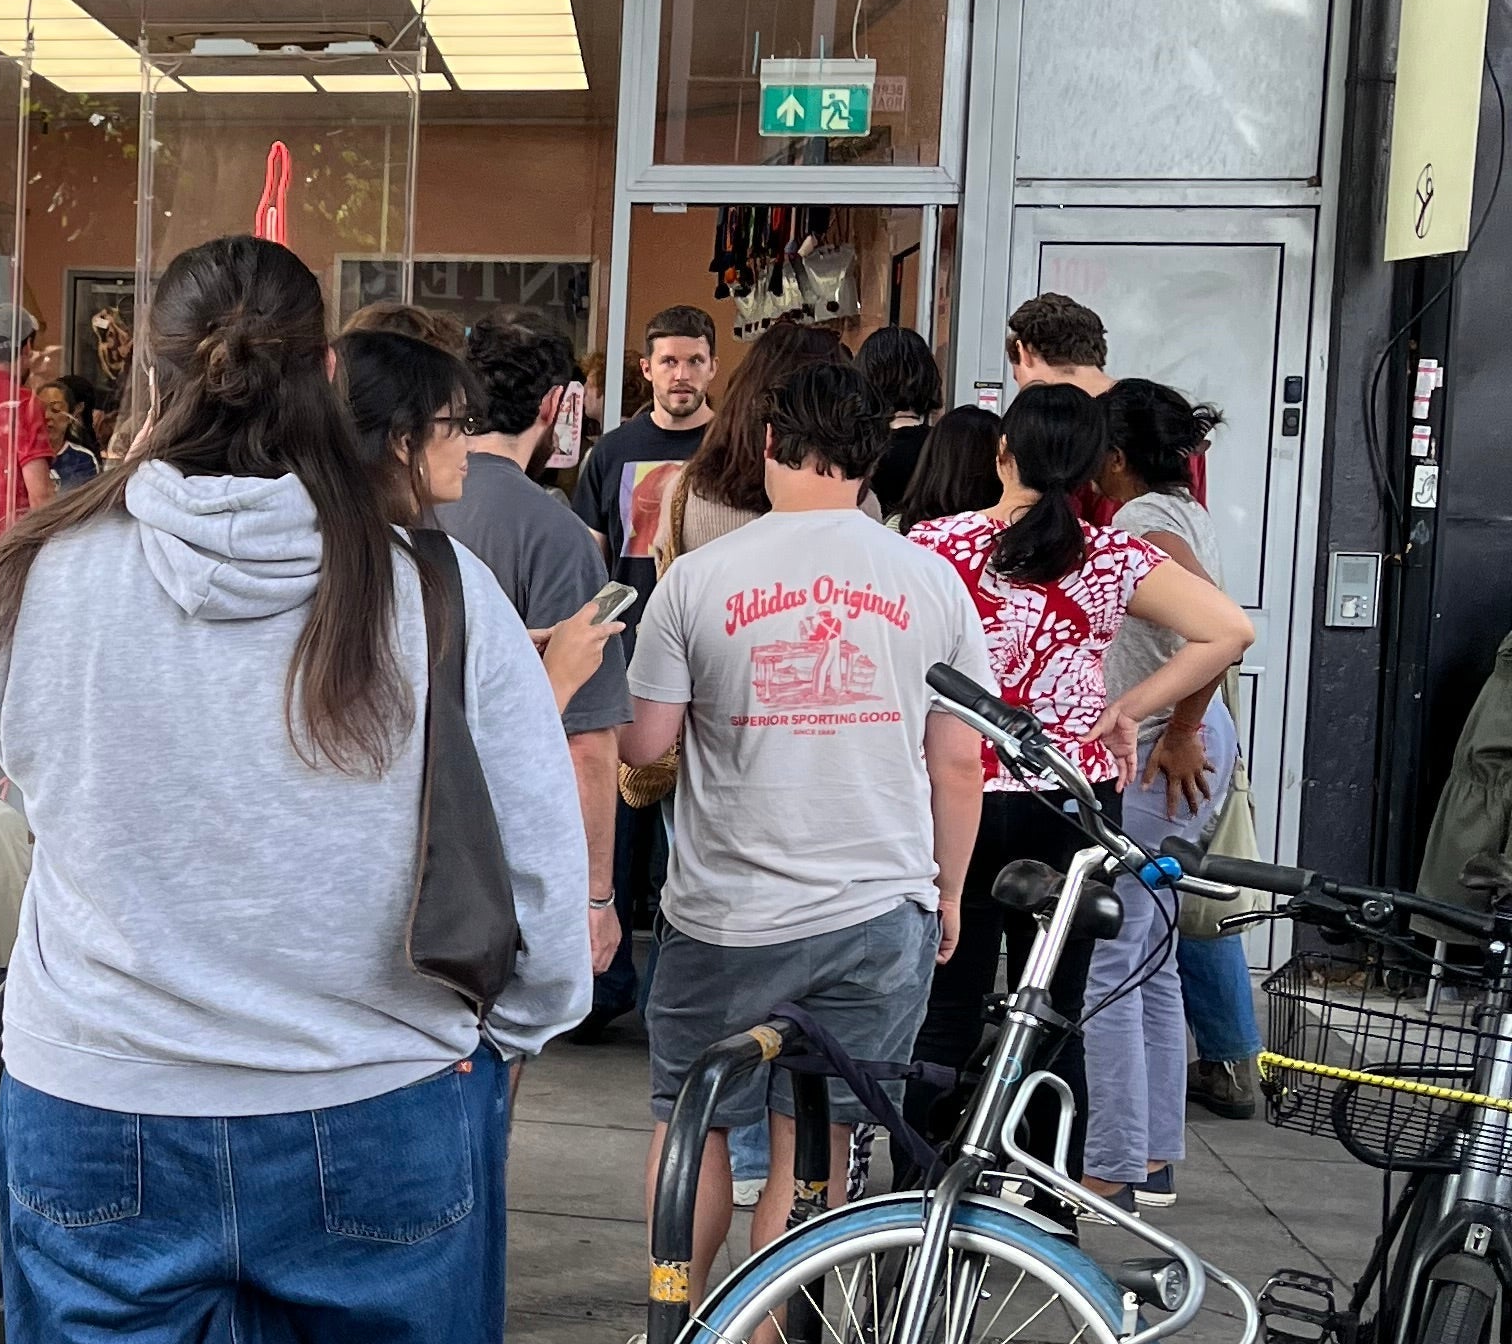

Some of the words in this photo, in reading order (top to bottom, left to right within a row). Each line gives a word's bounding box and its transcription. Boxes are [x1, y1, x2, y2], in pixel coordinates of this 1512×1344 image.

[725, 582, 807, 636] Adidas
[813, 575, 910, 631] Originals
[730, 715, 788, 726] SUPERIOR
[791, 713, 857, 725] SPORTING
[859, 712, 903, 723] GOOD
